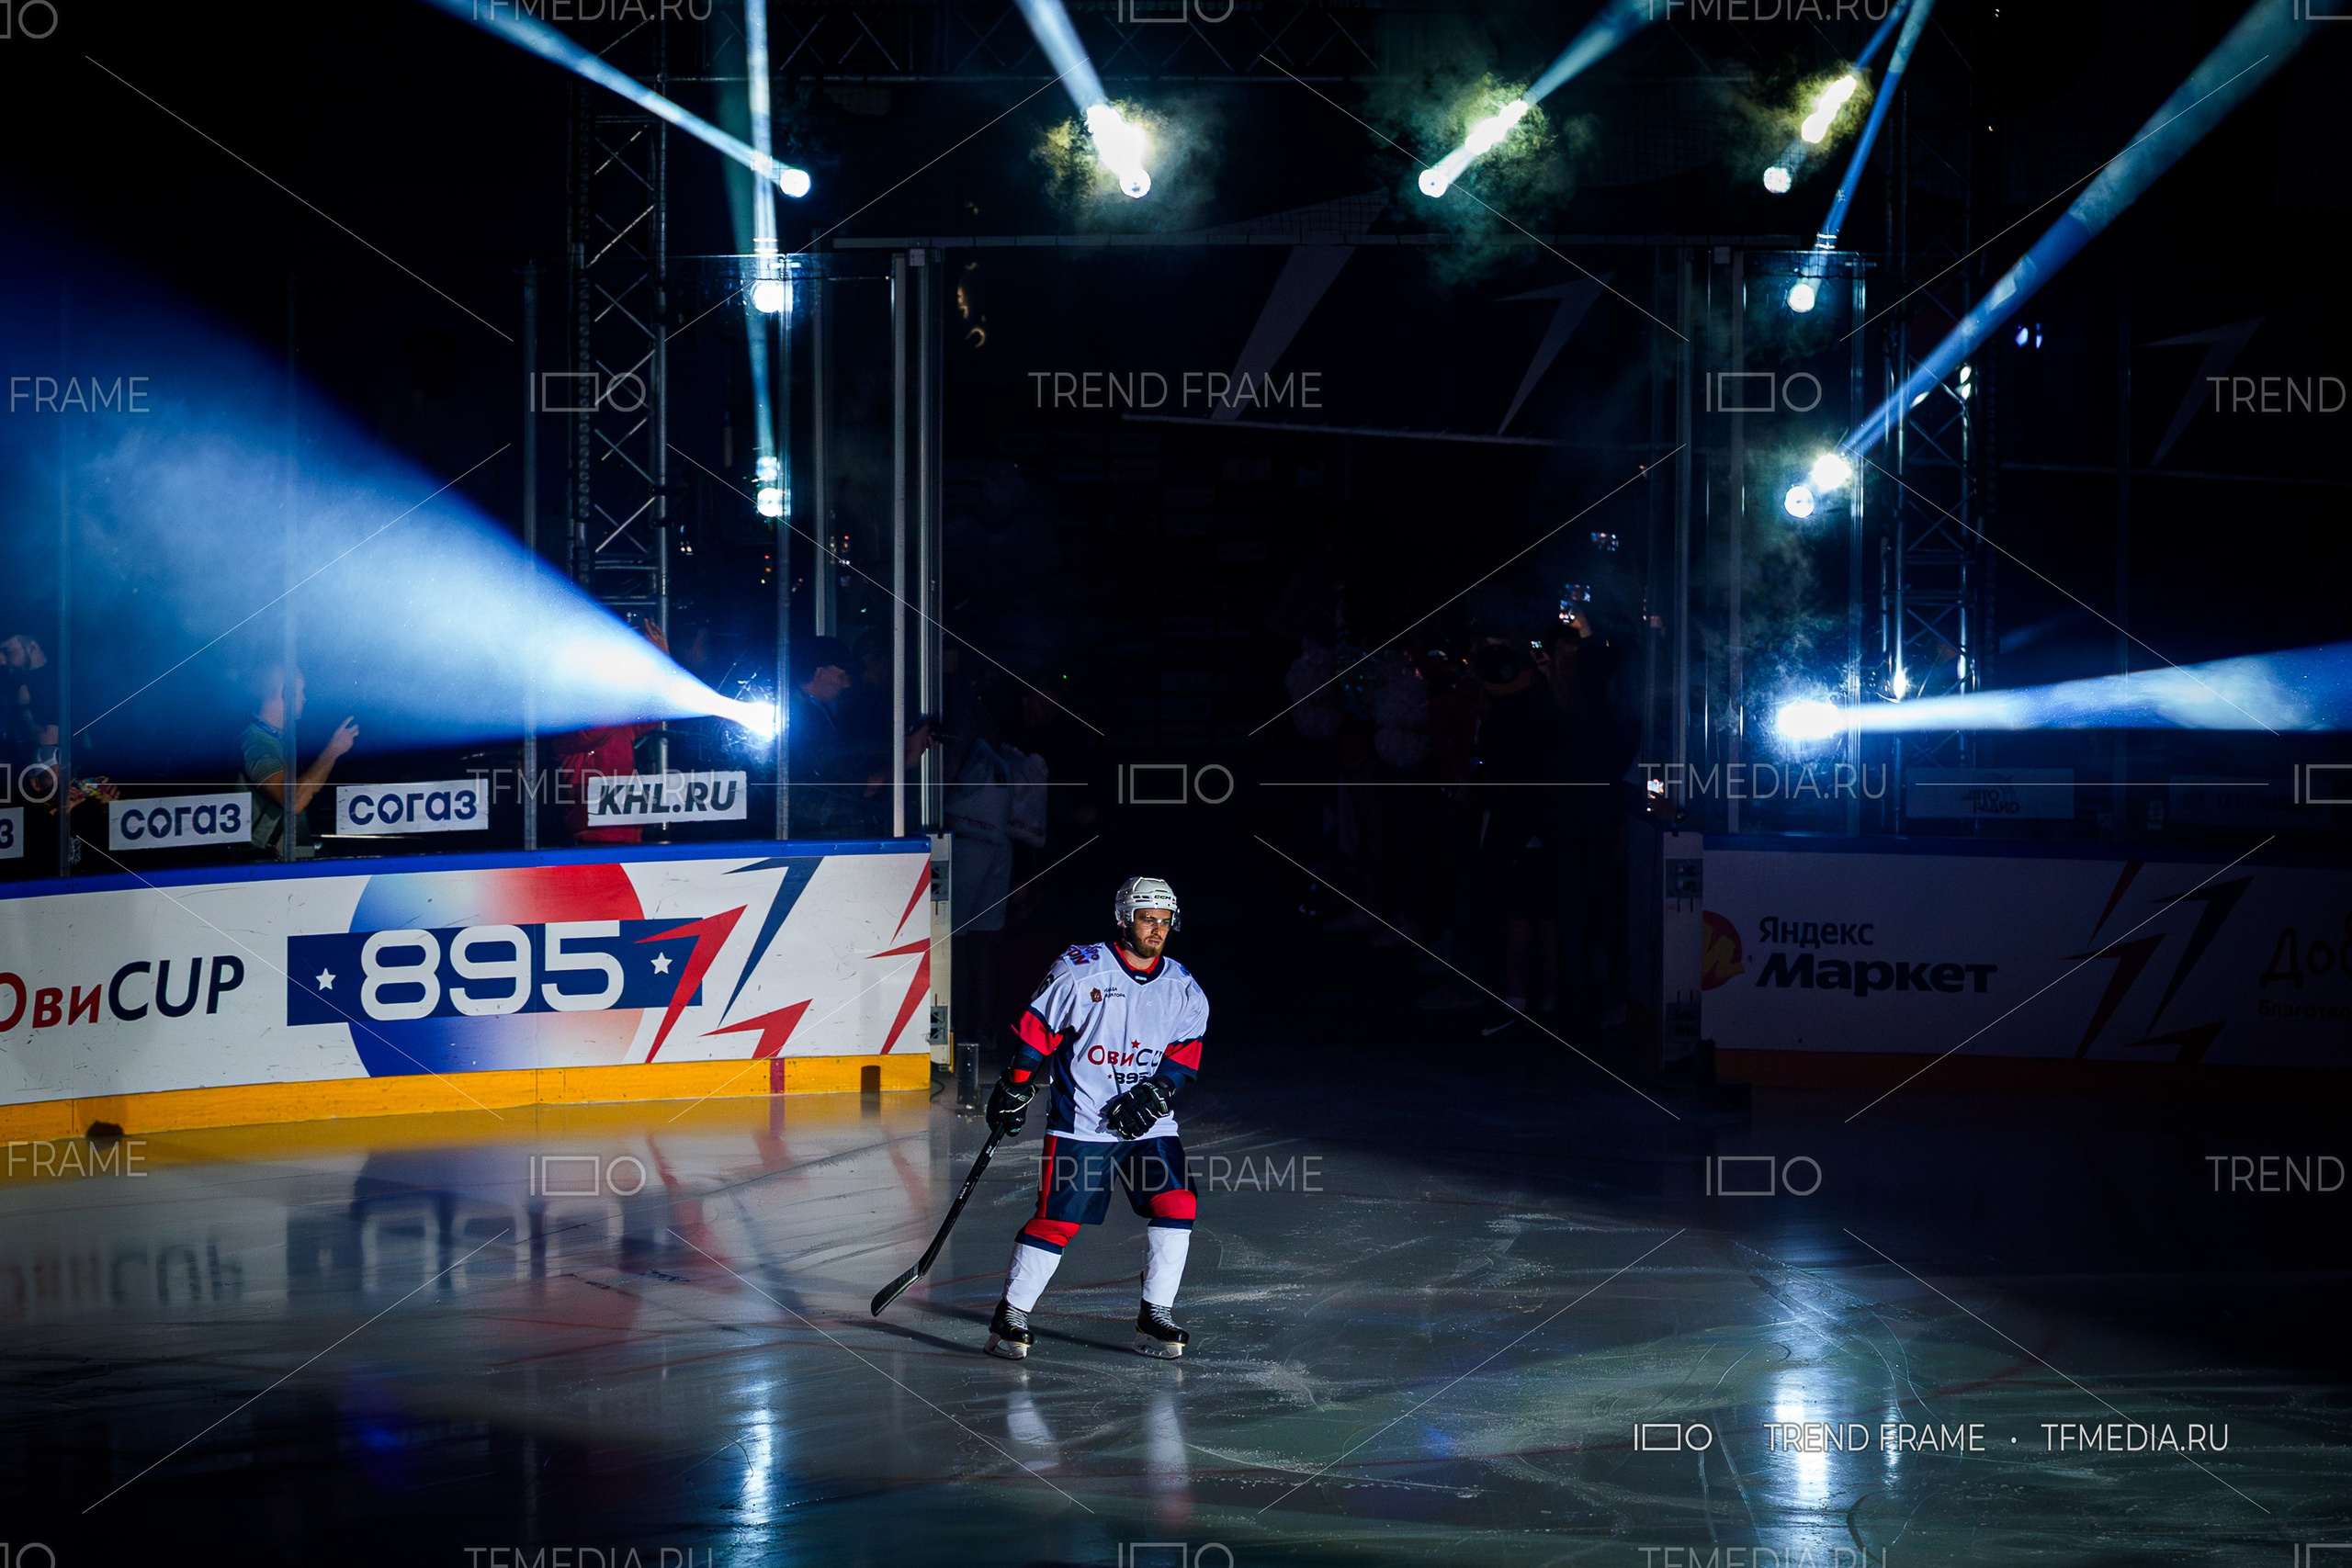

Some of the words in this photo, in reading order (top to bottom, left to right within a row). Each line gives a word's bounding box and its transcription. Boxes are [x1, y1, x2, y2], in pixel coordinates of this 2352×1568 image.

[597, 780, 737, 816] KHL.RU
[1758, 916, 1874, 947] Яндекс
[360, 919, 625, 1022] 895
[1756, 952, 1998, 997] Маркет
